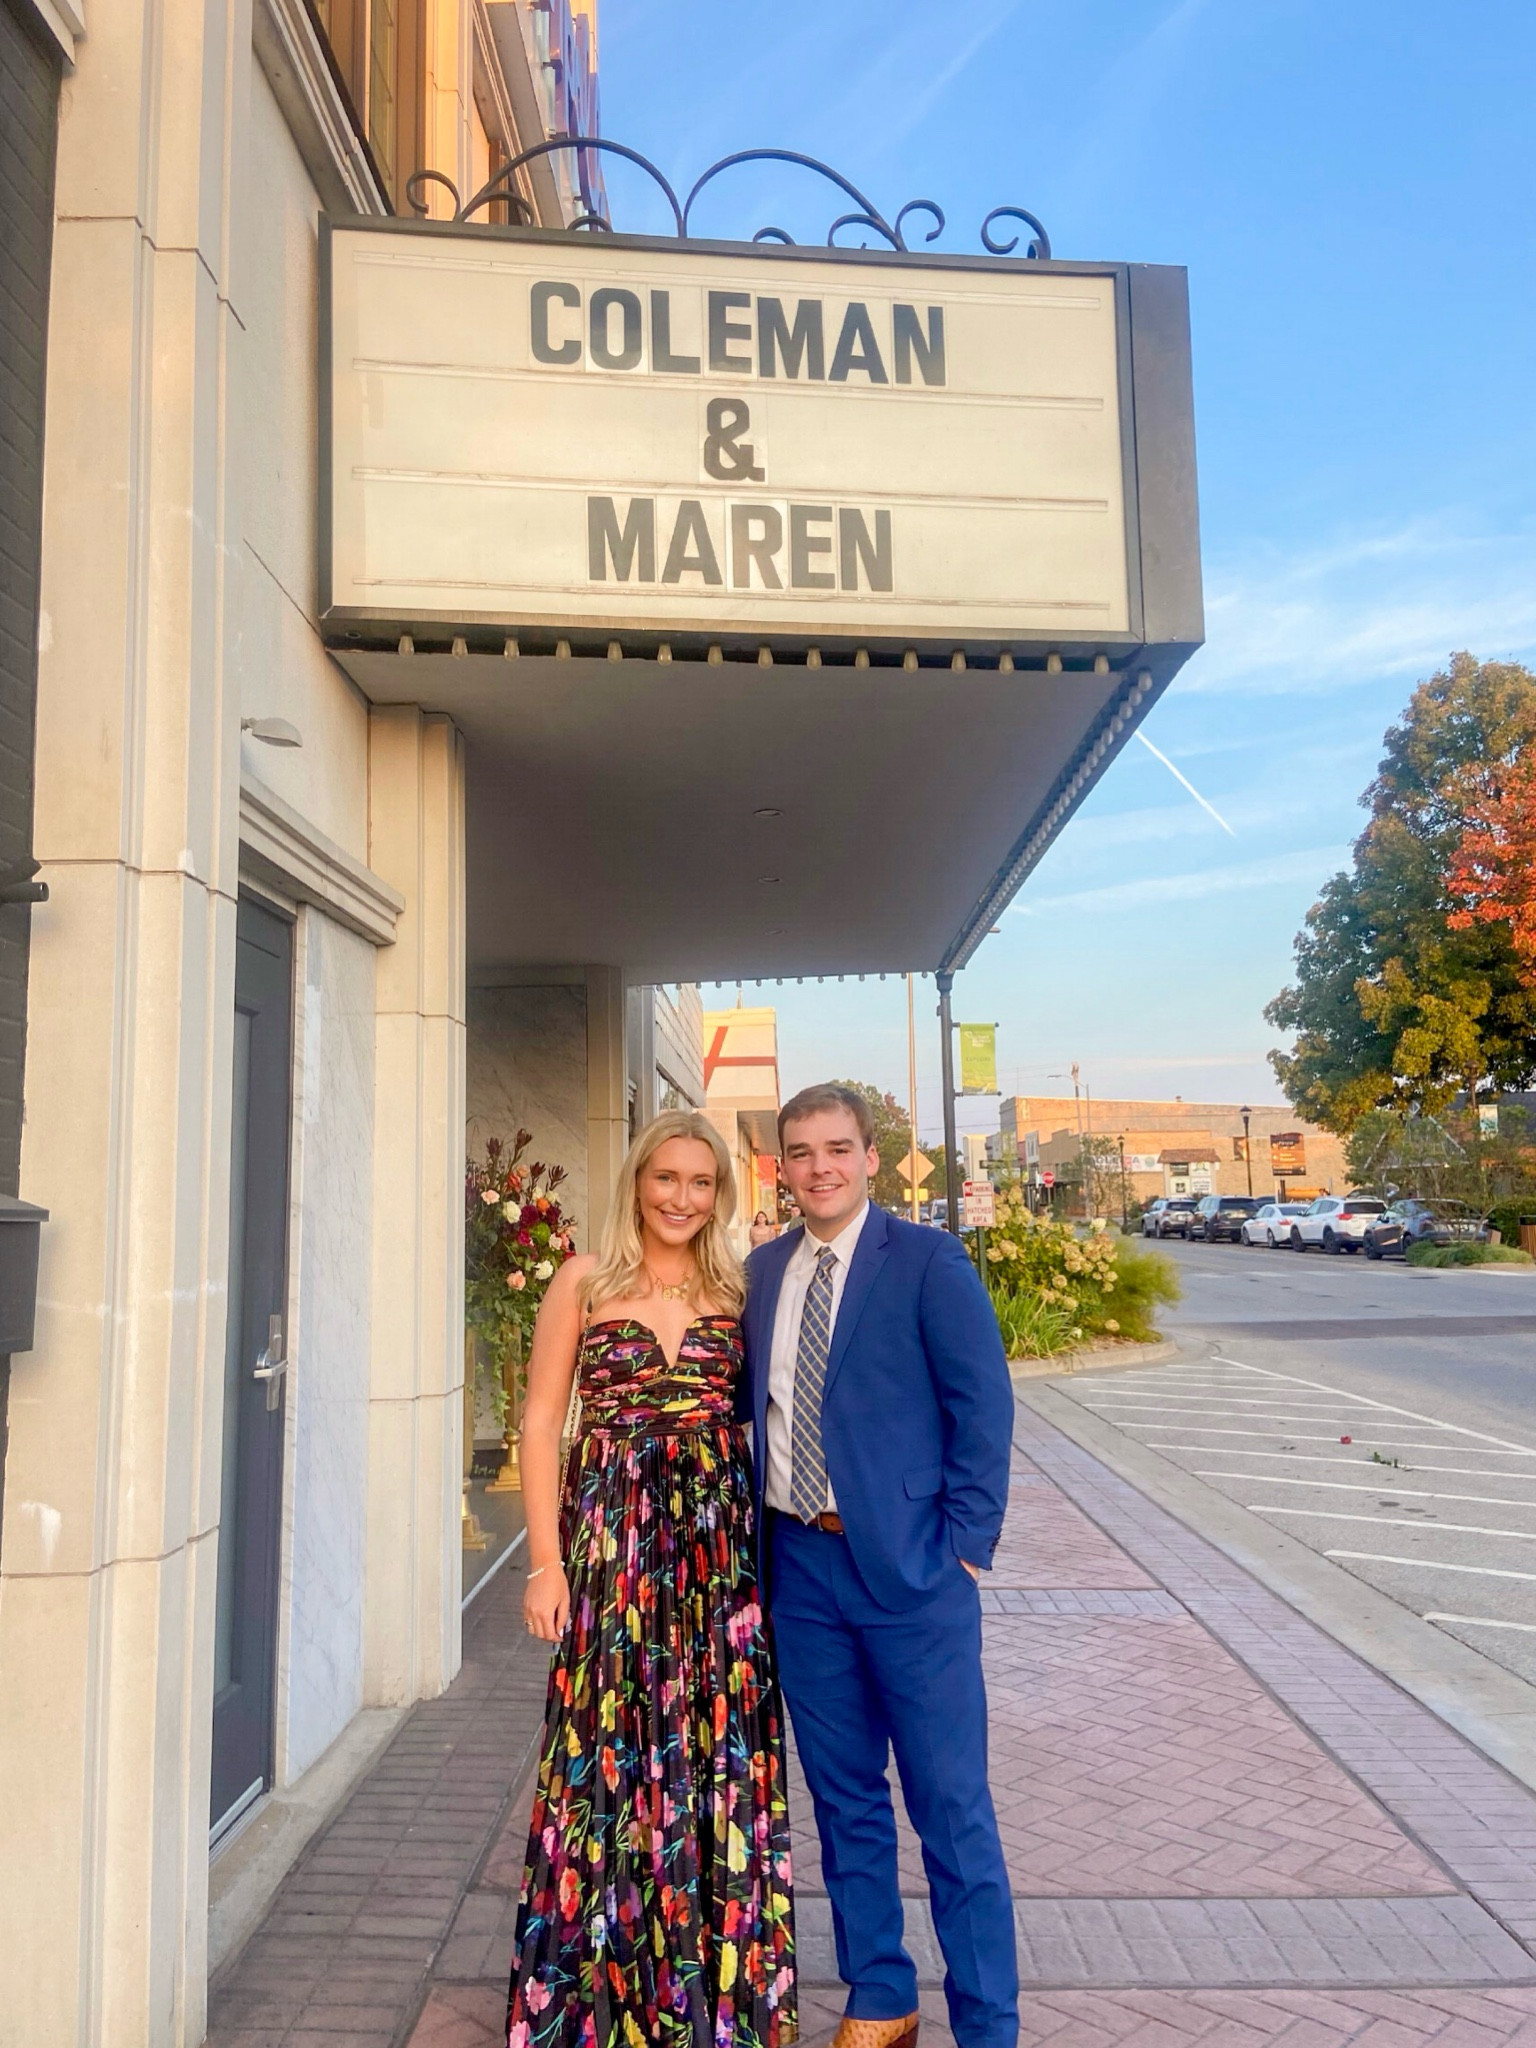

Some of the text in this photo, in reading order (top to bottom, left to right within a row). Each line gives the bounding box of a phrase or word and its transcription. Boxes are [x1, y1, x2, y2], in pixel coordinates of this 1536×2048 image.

[531, 281, 944, 386] COLEMAN
[704, 397, 765, 481] &
[588, 497, 893, 592] MAREN
